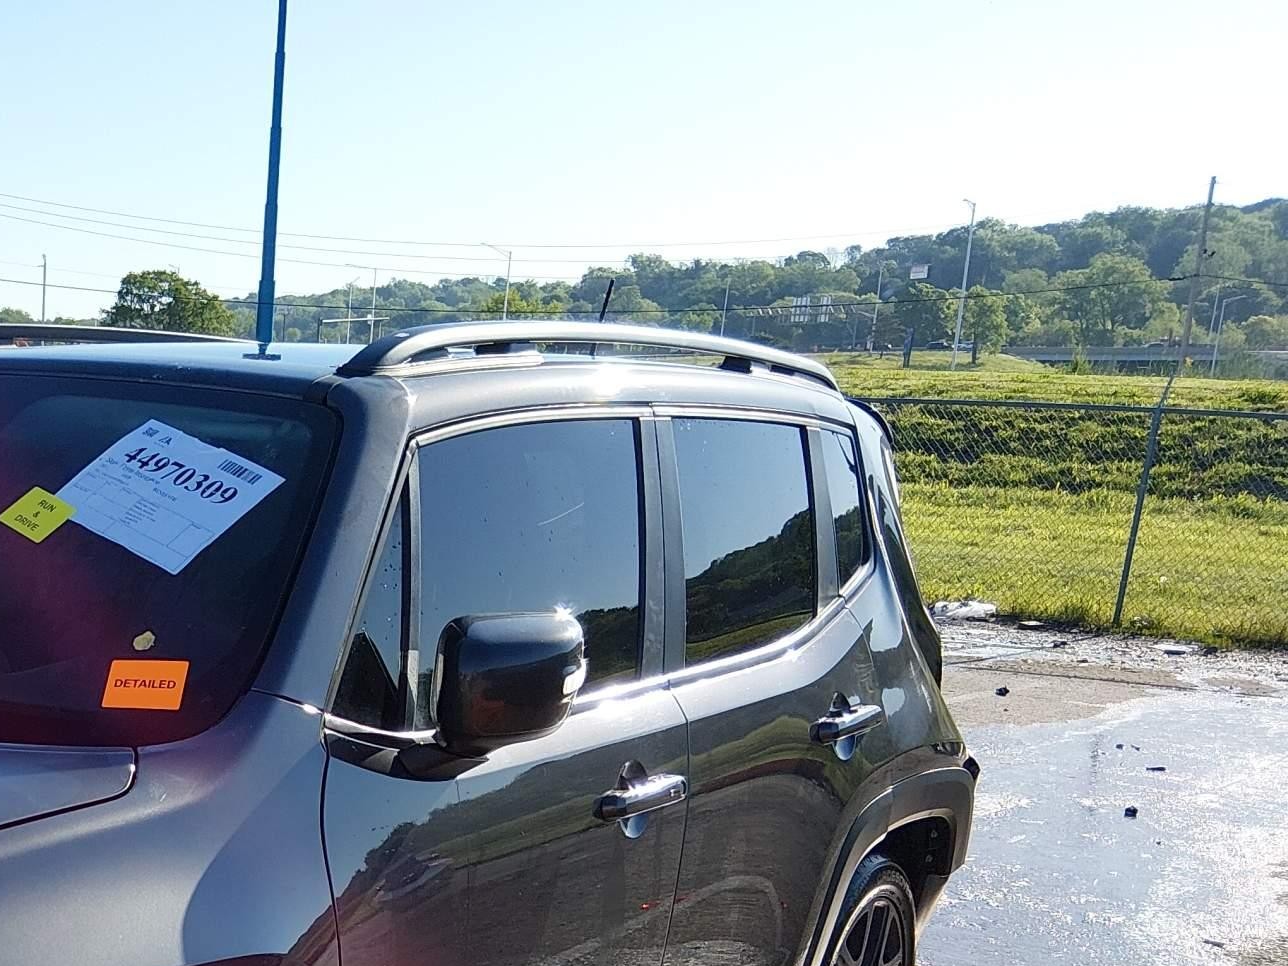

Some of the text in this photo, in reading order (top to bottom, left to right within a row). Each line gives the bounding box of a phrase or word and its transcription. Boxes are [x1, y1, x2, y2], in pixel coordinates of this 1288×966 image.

[124, 447, 238, 504] 44970309
[37, 499, 57, 512] RUN
[14, 514, 40, 532] DRIVE
[113, 678, 177, 689] DETAILED
